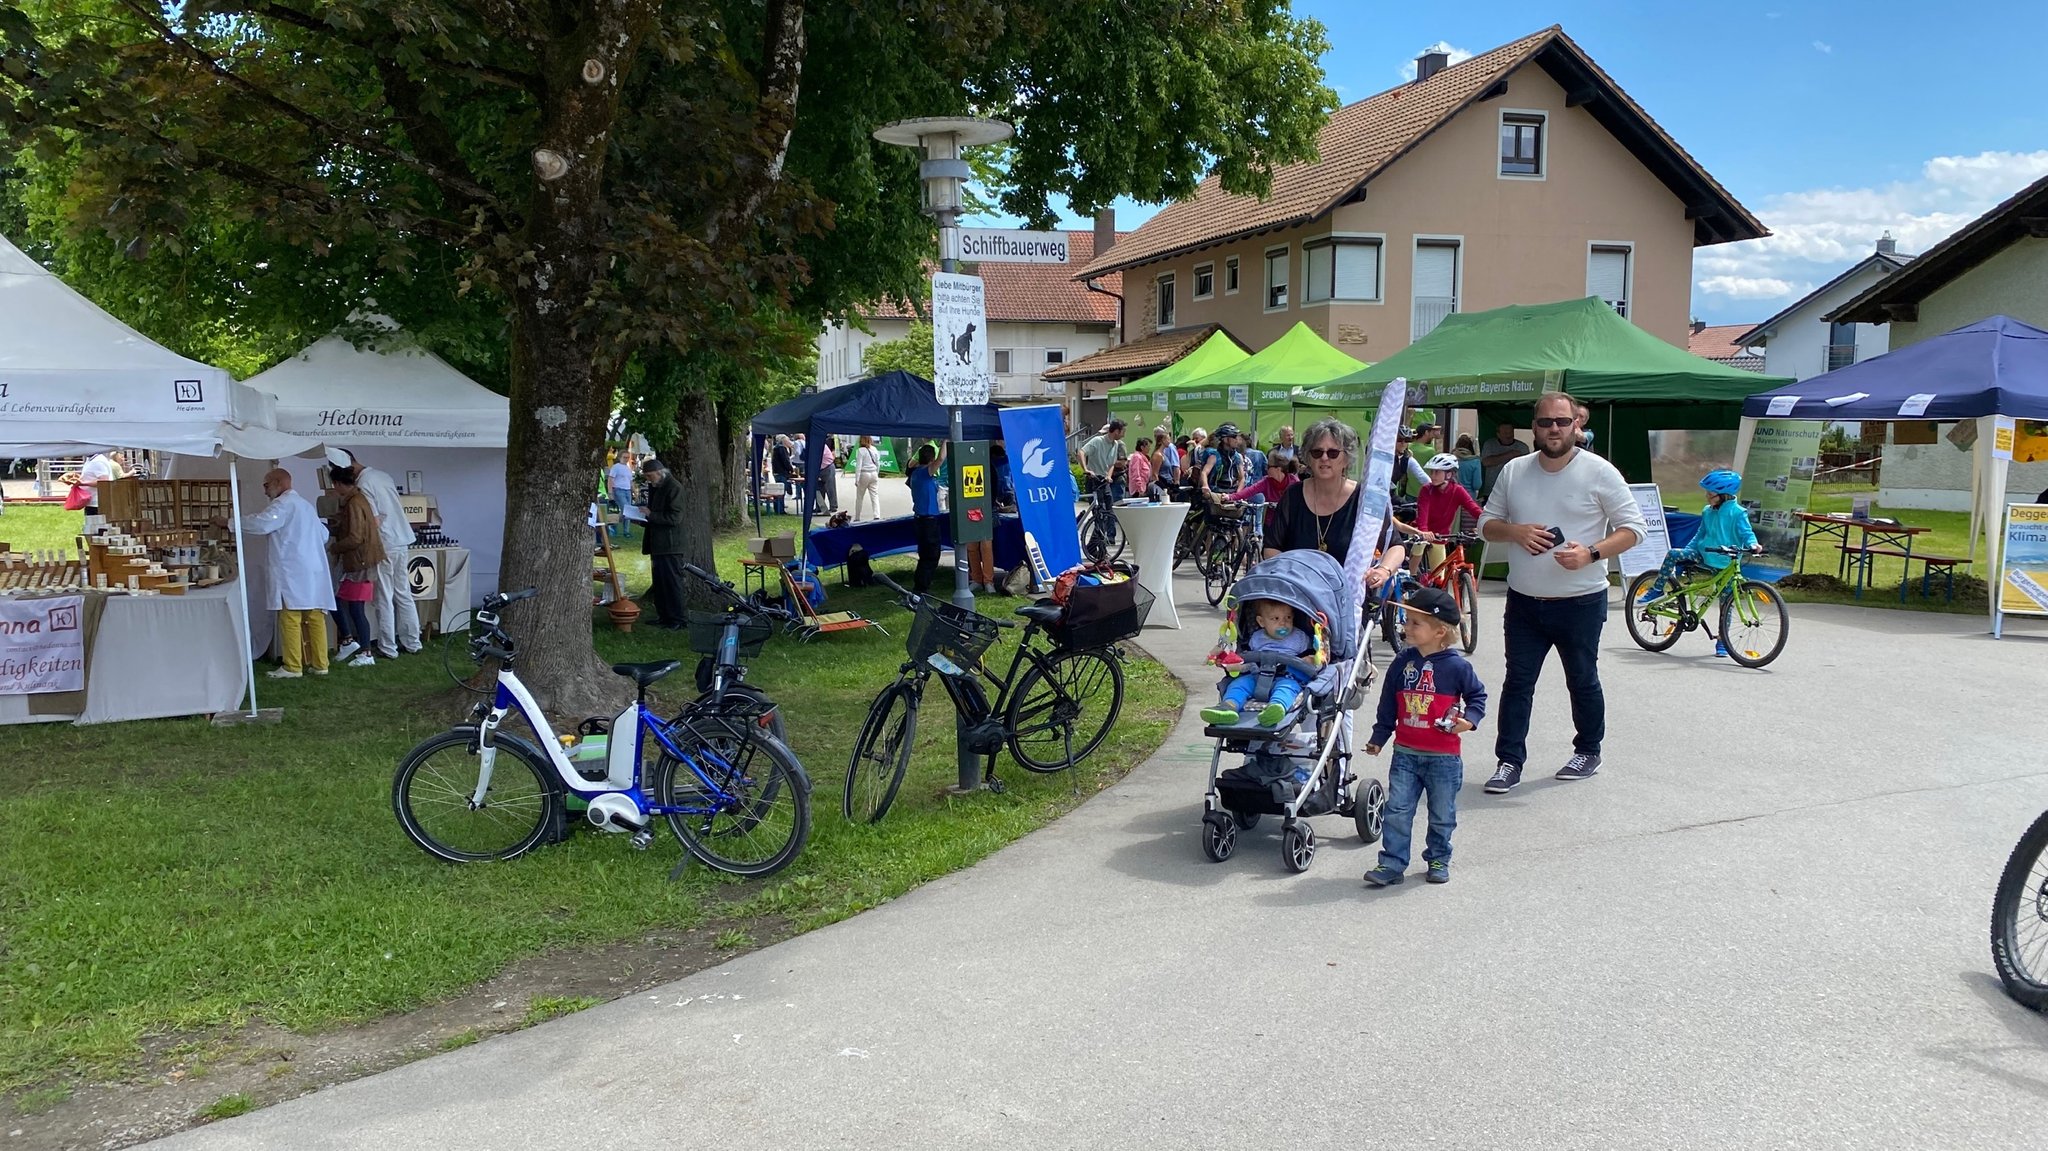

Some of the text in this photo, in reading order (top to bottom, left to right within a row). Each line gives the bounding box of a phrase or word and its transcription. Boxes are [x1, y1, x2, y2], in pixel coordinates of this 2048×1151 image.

[962, 235, 1066, 261] Schiffbauerweg
[934, 281, 952, 290] Liebe
[962, 306, 981, 316] Hunde
[1434, 385, 1446, 397] Wir
[1447, 384, 1478, 395] schützen
[1480, 381, 1510, 394] Bayerns
[1511, 380, 1535, 391] Natur.
[1307, 390, 1331, 400] Bayern
[11, 402, 116, 415] Lebenswürdigkeiten
[317, 409, 404, 427] Hedonna
[292, 428, 350, 437] naturbelassener
[352, 429, 387, 438] Kosmetik
[387, 429, 401, 437] und
[403, 429, 476, 440] Lebenswürdigkeiten
[1775, 429, 1820, 439] Naturschutz
[1028, 486, 1058, 503] LBV
[2010, 508, 2048, 521] Degge
[2009, 522, 2042, 531] braucht
[2009, 531, 2047, 543] Klima
